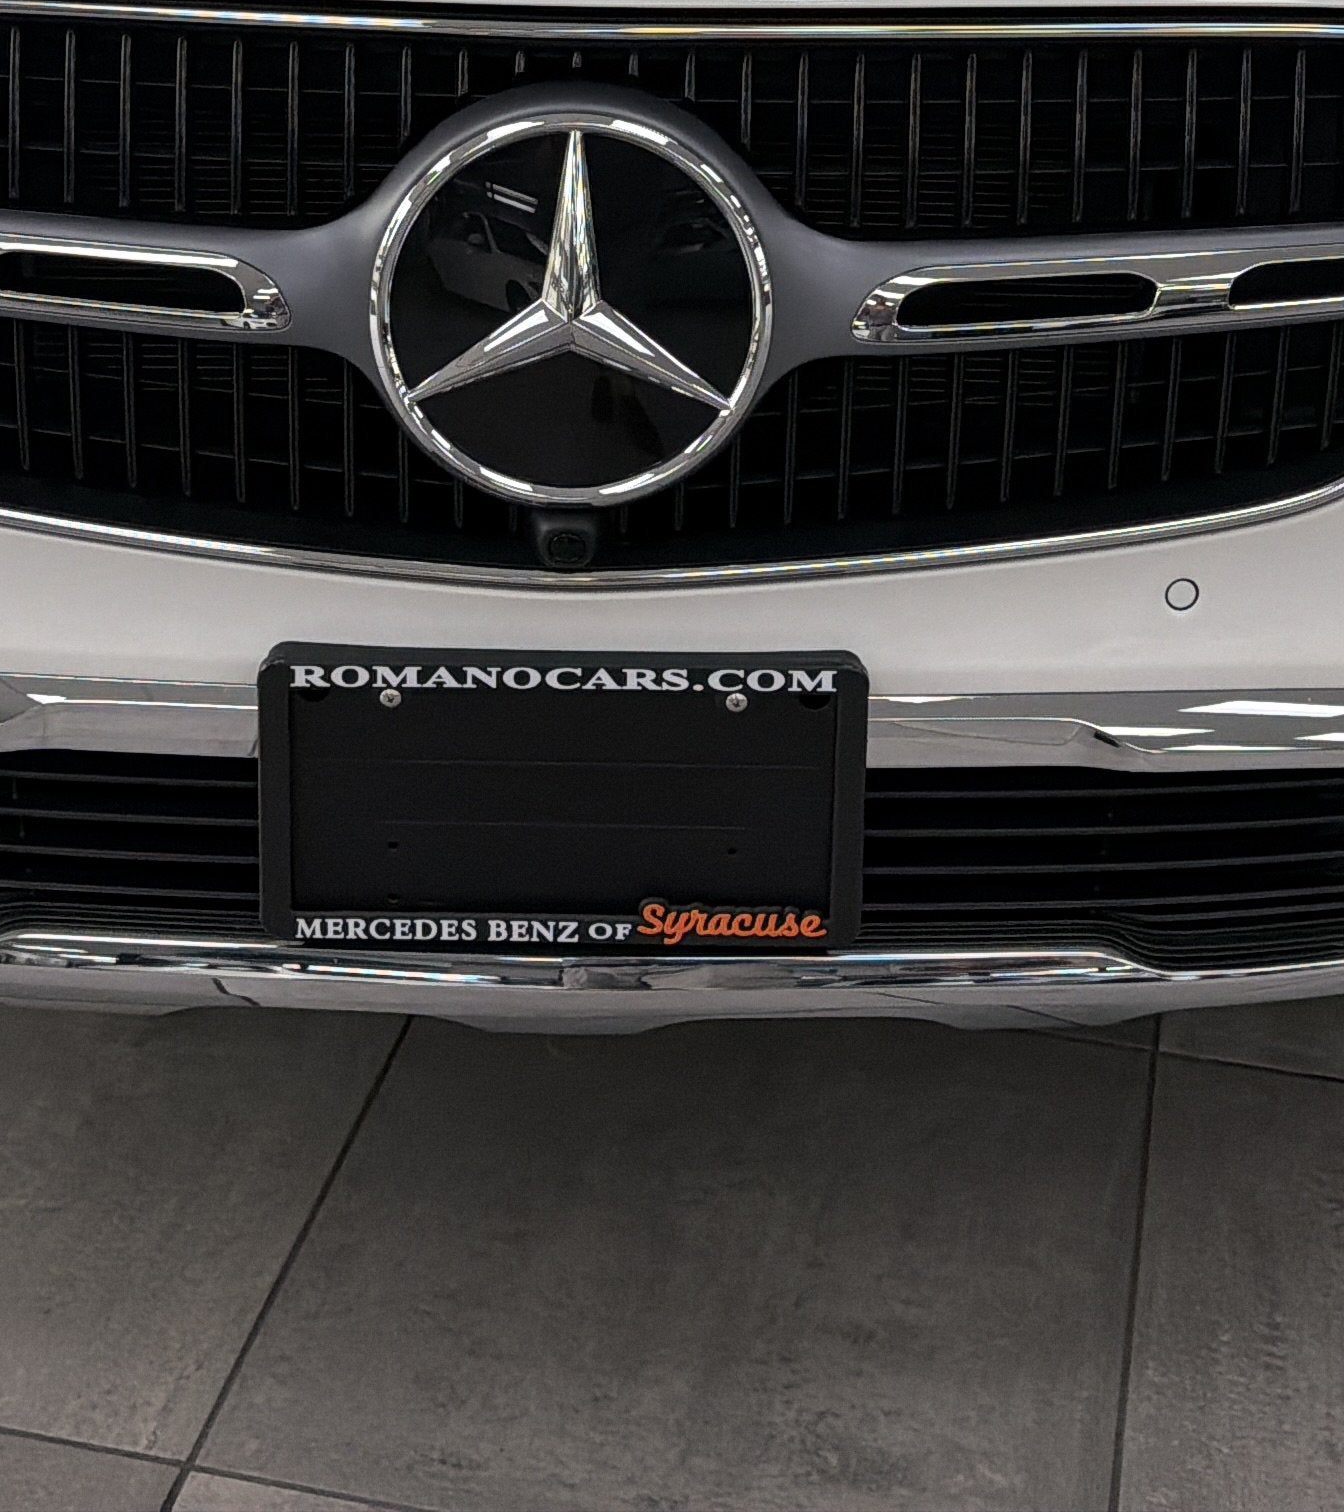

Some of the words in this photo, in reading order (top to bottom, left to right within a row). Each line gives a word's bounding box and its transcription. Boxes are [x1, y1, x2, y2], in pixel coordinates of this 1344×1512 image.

[289, 664, 839, 693] ROMANOCARS.COM
[294, 917, 478, 941] MERCEDES
[487, 919, 580, 944] BENZ
[587, 922, 633, 941] OF
[636, 902, 828, 946] Syracuse
